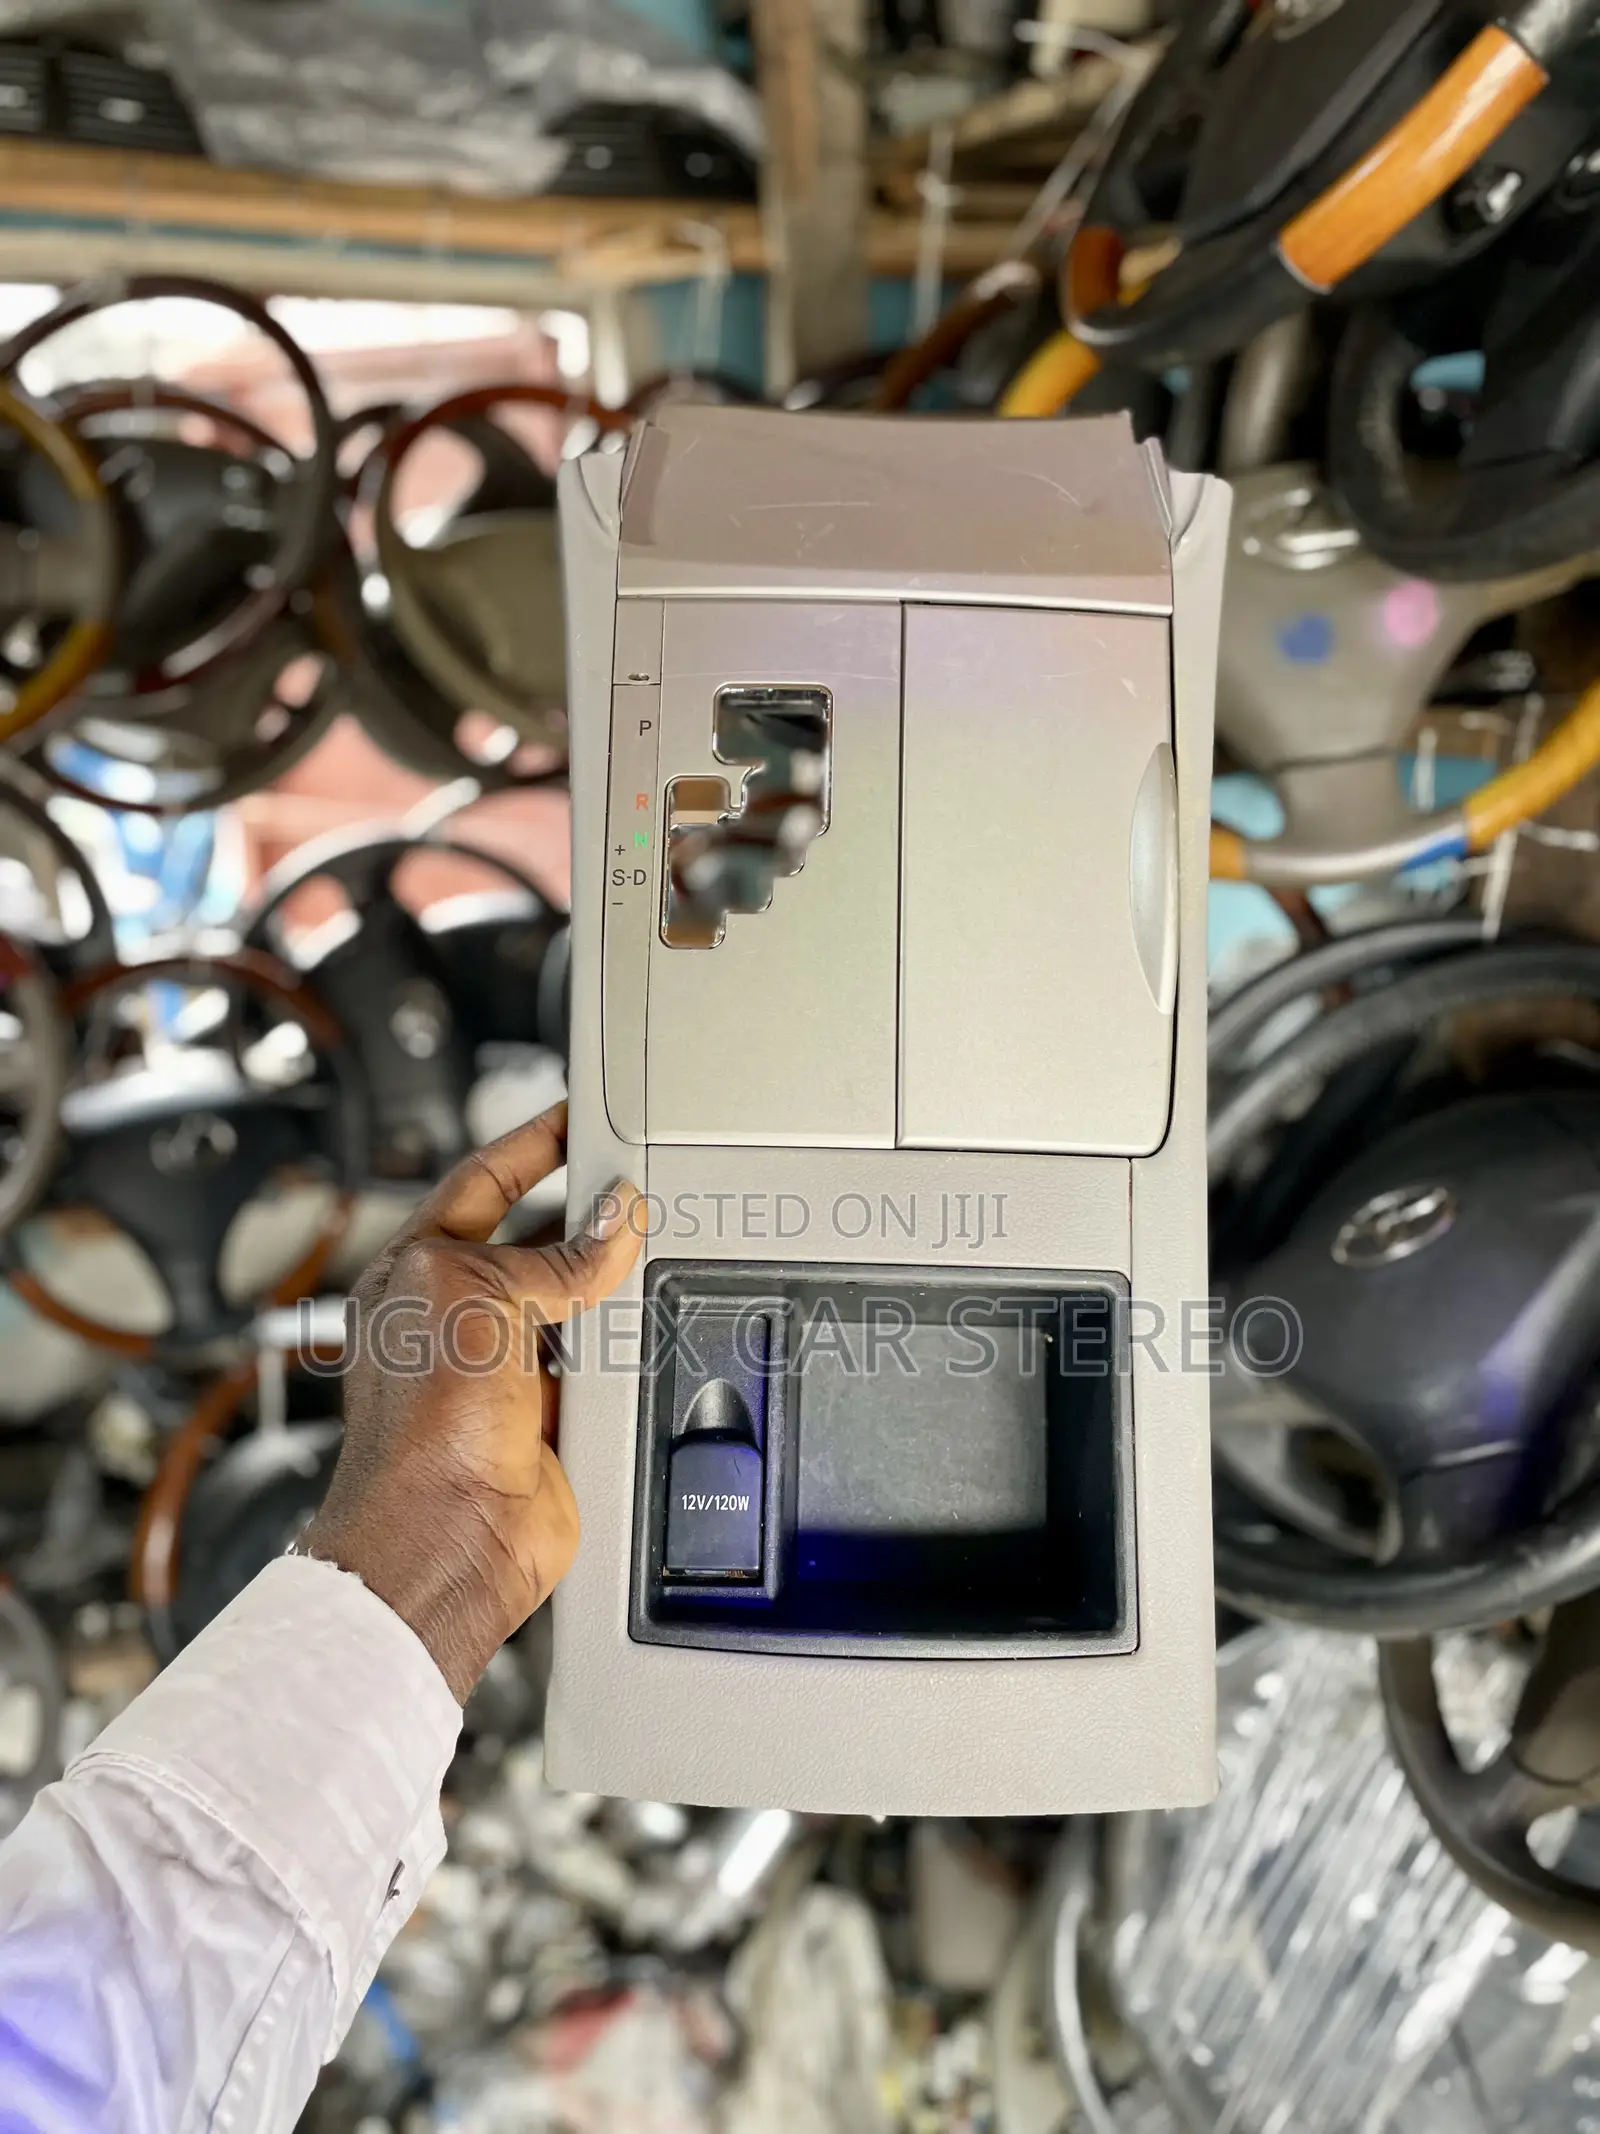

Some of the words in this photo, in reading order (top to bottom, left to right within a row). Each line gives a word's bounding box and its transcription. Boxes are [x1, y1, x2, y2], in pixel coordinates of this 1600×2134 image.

[639, 720, 652, 736] P
[636, 794, 649, 810] R
[634, 832, 648, 848] N
[681, 1494, 750, 1511] 12V/120W
